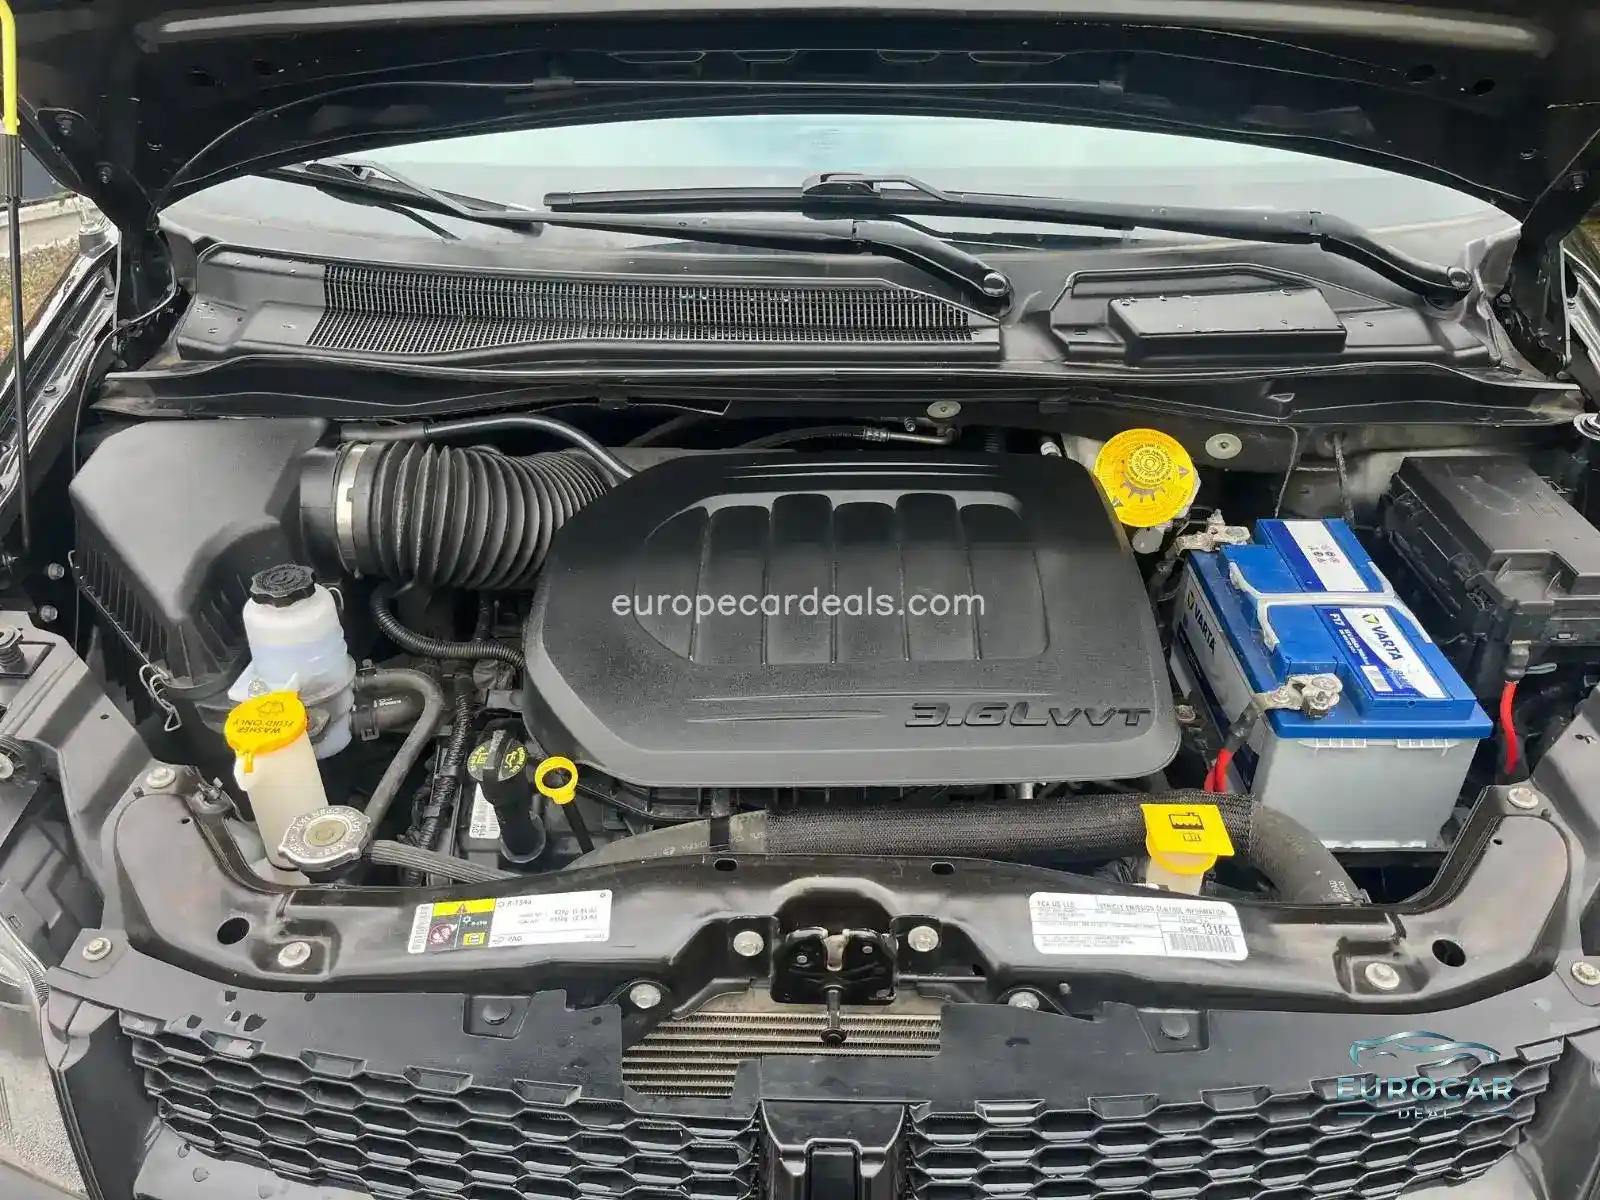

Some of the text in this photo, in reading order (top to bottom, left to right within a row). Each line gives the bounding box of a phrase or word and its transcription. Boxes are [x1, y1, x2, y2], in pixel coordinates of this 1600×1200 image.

[1194, 600, 1216, 655] VARTA
[1329, 613, 1346, 627] F17
[1371, 625, 1403, 660] VARTA
[236, 726, 281, 734] WASHER
